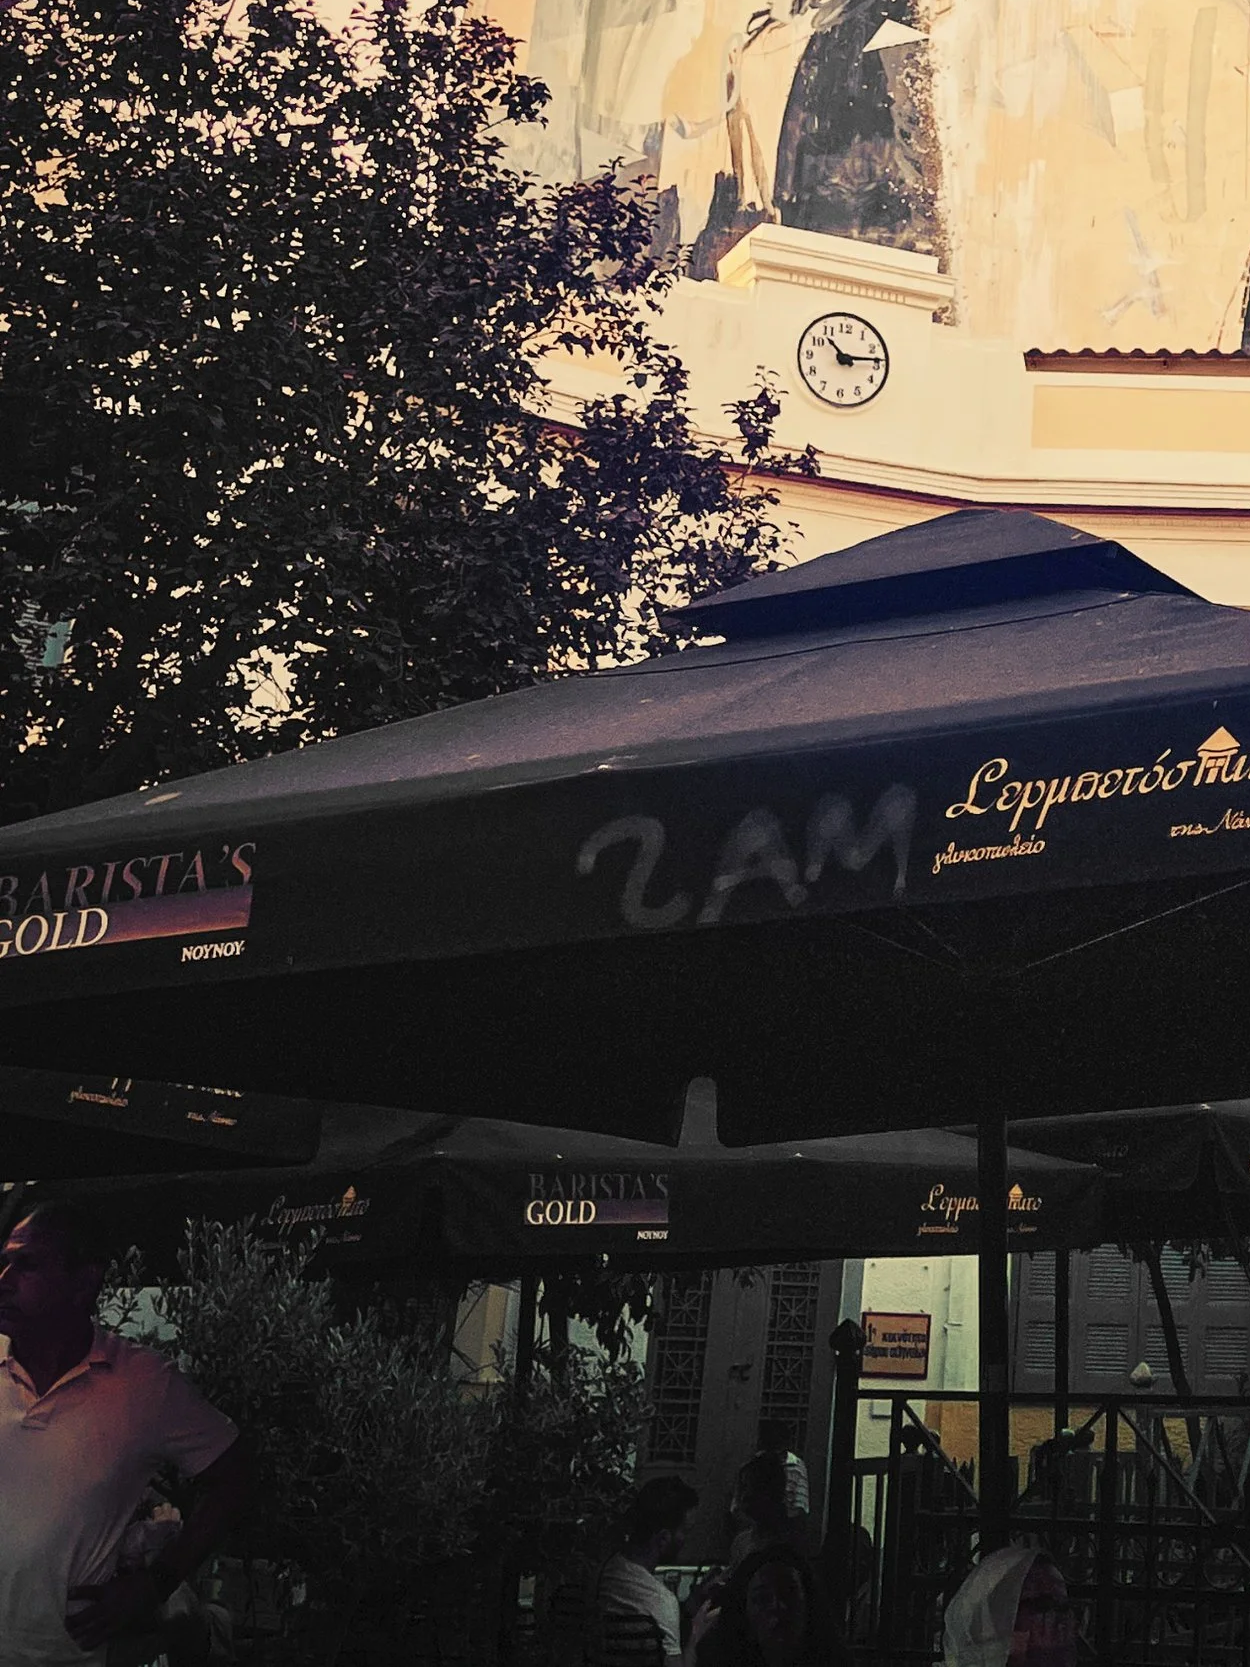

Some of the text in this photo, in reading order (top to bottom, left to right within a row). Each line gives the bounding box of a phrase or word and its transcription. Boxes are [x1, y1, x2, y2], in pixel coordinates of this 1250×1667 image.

[823, 325, 835, 336] 11
[838, 323, 853, 334] 12
[860, 330, 865, 341] 1
[812, 336, 824, 347] 10
[869, 343, 876, 354] 2
[806, 349, 814, 360] 9
[809, 365, 817, 376] 8
[867, 374, 874, 384] 4
[820, 380, 827, 391] 7
[854, 386, 861, 396] 5
[836, 388, 844, 398] 6
[932, 833, 1046, 875] γλυκοπωλείο
[528, 1173, 669, 1200] BARISTA'S
[526, 1199, 597, 1226] GOLD
